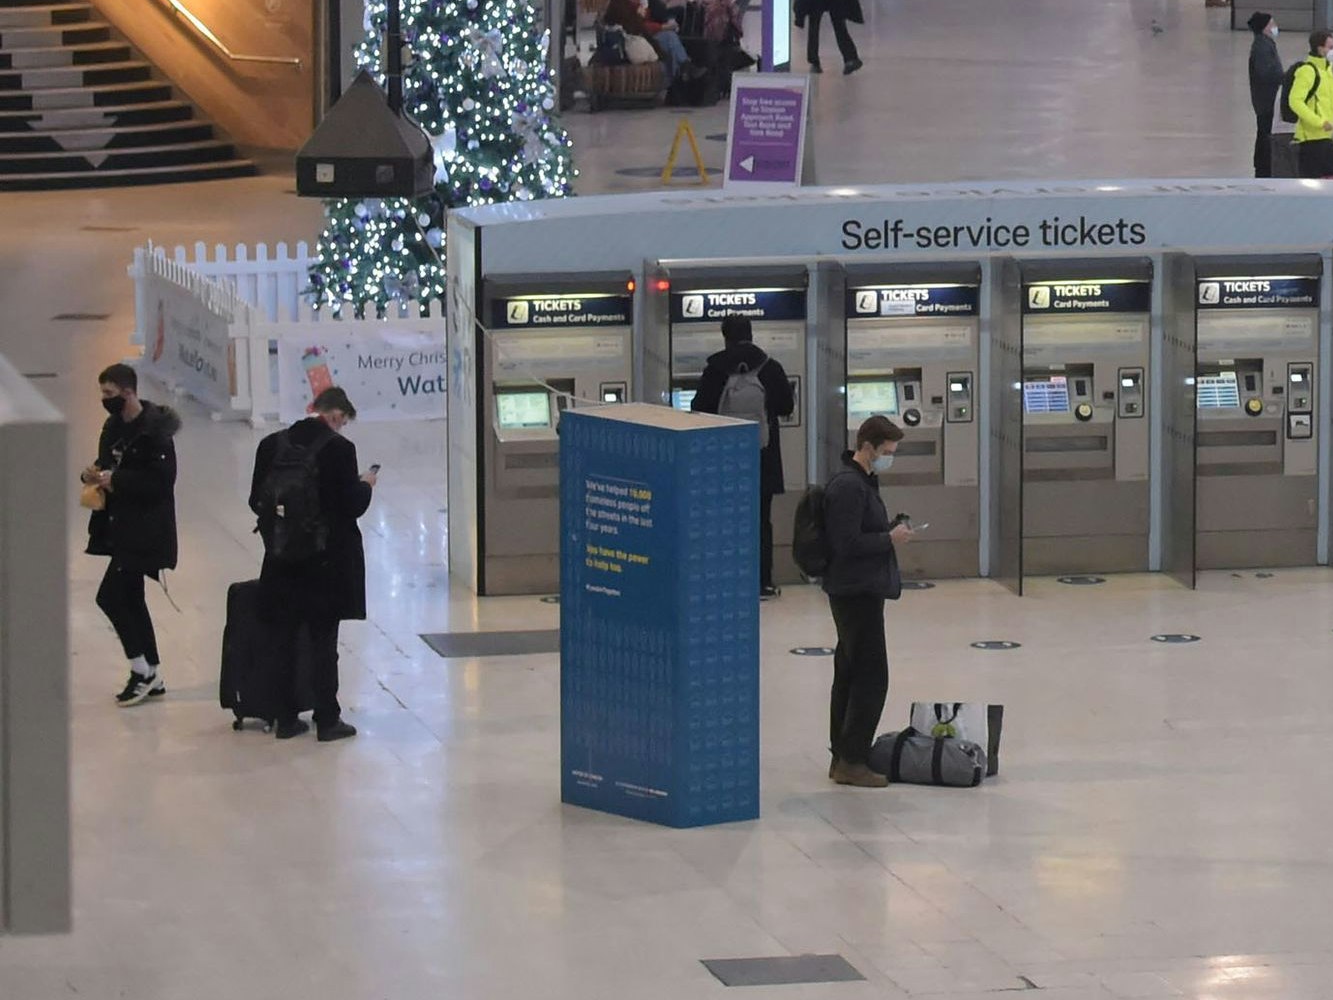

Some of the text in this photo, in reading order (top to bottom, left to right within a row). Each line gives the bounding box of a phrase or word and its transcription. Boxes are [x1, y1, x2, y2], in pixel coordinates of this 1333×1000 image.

[842, 216, 1146, 250] Self-service tickets
[1054, 285, 1101, 297] TICKETS
[1224, 281, 1270, 292] TICKETS
[708, 294, 755, 305] TICKETS
[881, 290, 929, 301] TICKETS
[1224, 295, 1242, 304] Cash
[1243, 295, 1257, 304] and
[1258, 295, 1275, 303] Card
[533, 300, 581, 312] TICKETS
[916, 303, 972, 313] Card Payments
[1054, 299, 1109, 309] Card Payments
[533, 313, 625, 323] Cash and Card Payments
[708, 308, 726, 317] Card
[358, 351, 447, 372] Merry Chris
[397, 375, 447, 396] Wat
